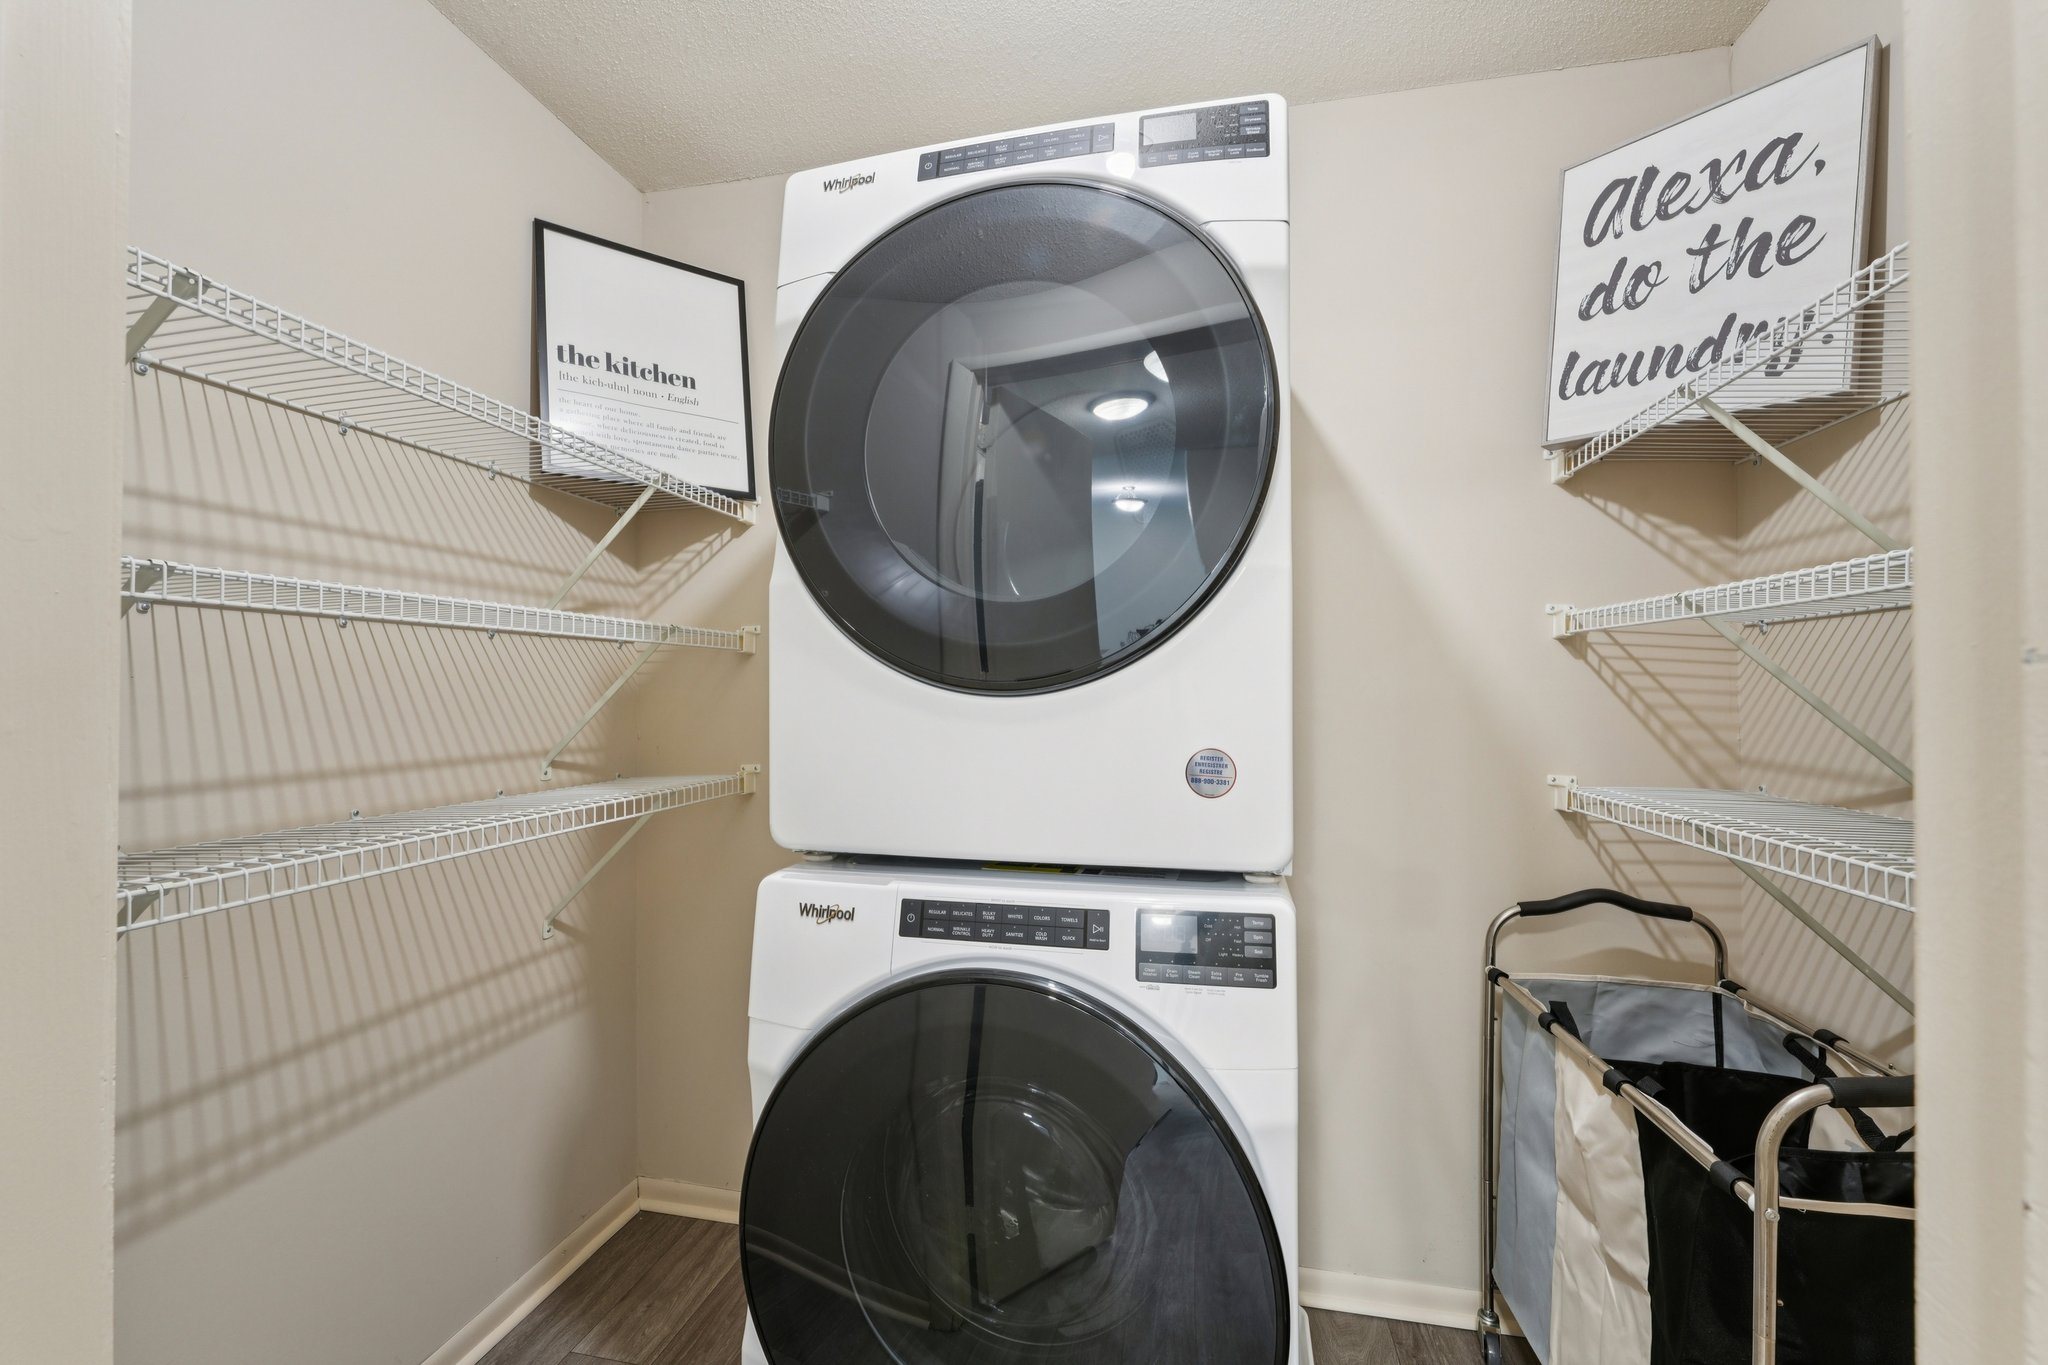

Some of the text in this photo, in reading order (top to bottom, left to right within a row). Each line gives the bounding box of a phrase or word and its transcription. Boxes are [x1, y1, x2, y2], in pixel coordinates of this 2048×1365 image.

[823, 172, 876, 194] Whirlpool
[1577, 214, 1828, 321] do the
[556, 344, 696, 390] the kitchen
[667, 393, 699, 407] English
[799, 902, 855, 925] Whirlpool
